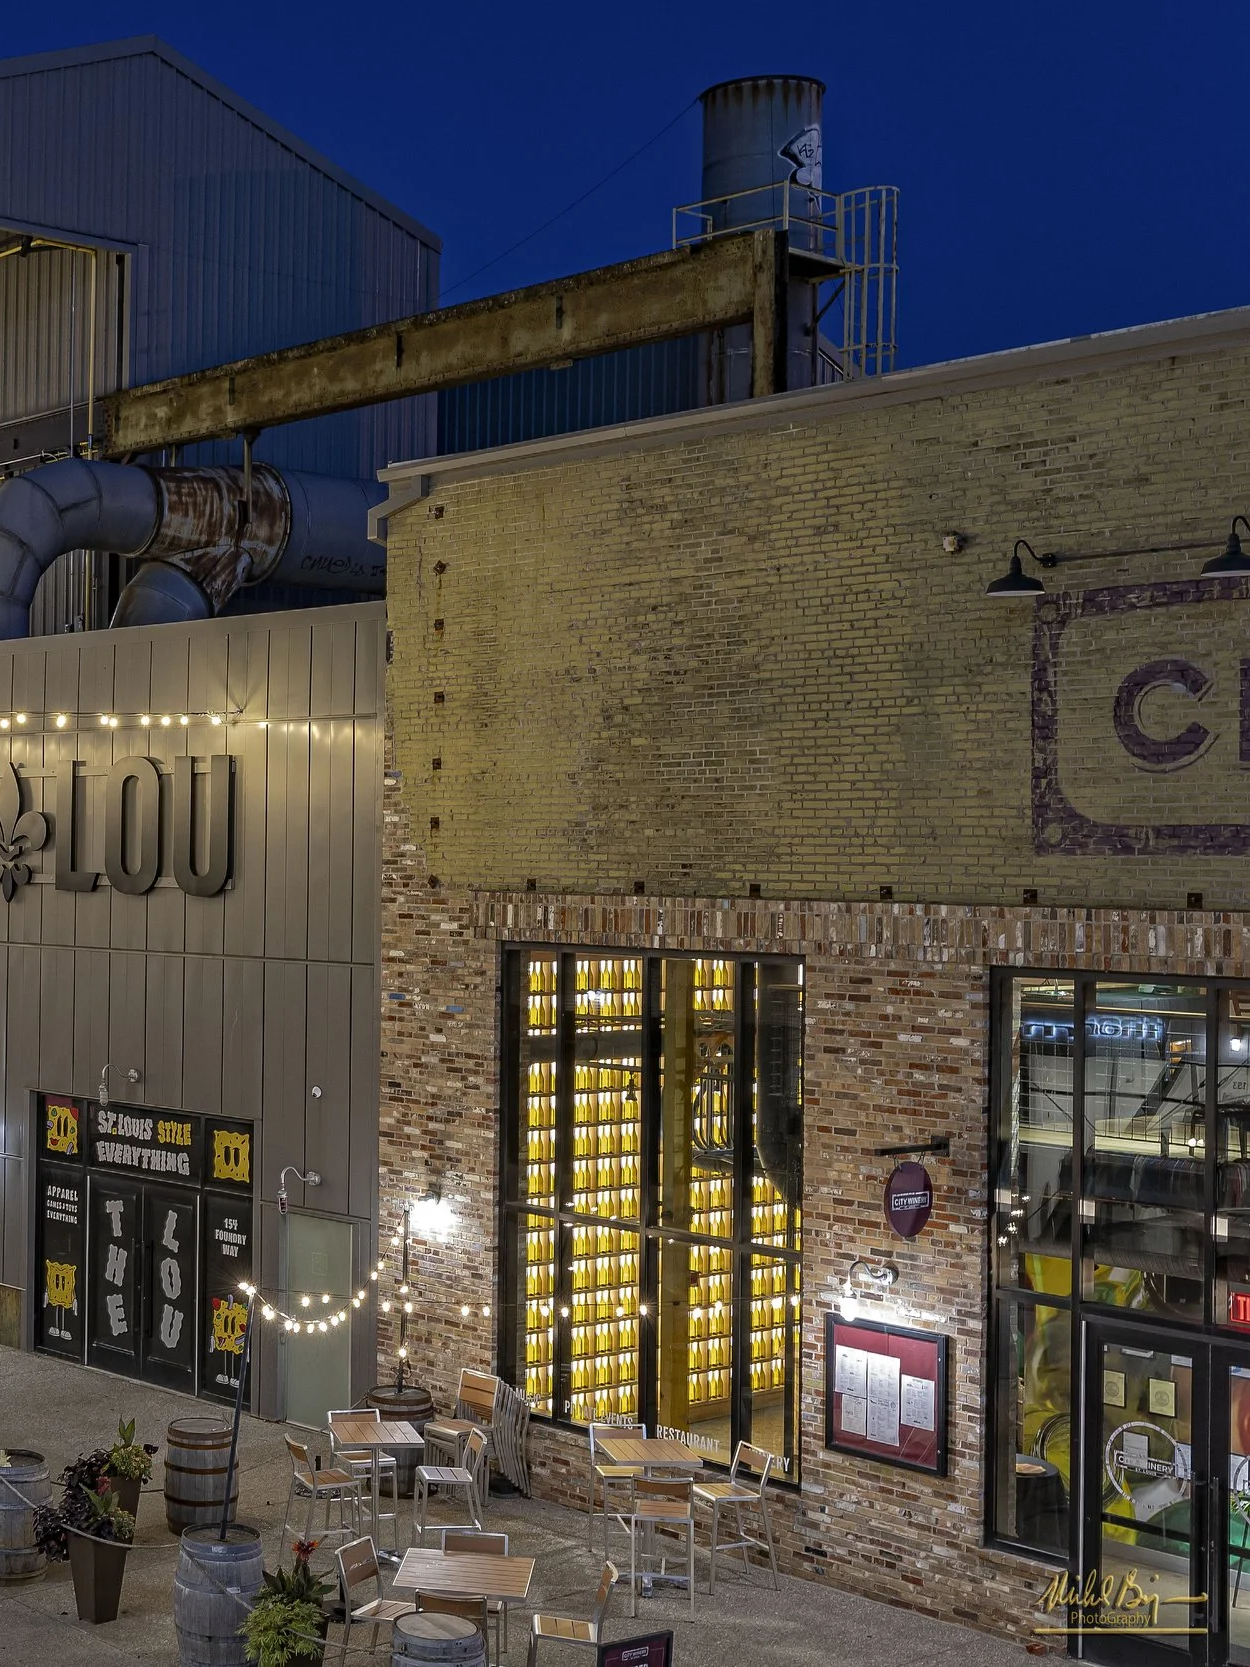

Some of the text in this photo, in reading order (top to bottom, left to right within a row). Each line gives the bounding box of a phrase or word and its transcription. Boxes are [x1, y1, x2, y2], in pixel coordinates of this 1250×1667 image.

[55, 754, 234, 898] LOU
[157, 1120, 192, 1146] STYLE
[96, 1140, 190, 1176] EVERYTHING
[47, 1185, 79, 1201] APPAREL
[894, 1197, 908, 1206] CITY
[47, 1209, 78, 1224] EVERYTHING
[224, 1217, 239, 1231] 154
[215, 1229, 247, 1246] FOUNDRY
[222, 1243, 239, 1258] WAY
[105, 1199, 128, 1337] THE
[159, 1209, 184, 1349] LOU
[656, 1424, 720, 1453] RESTAURANT
